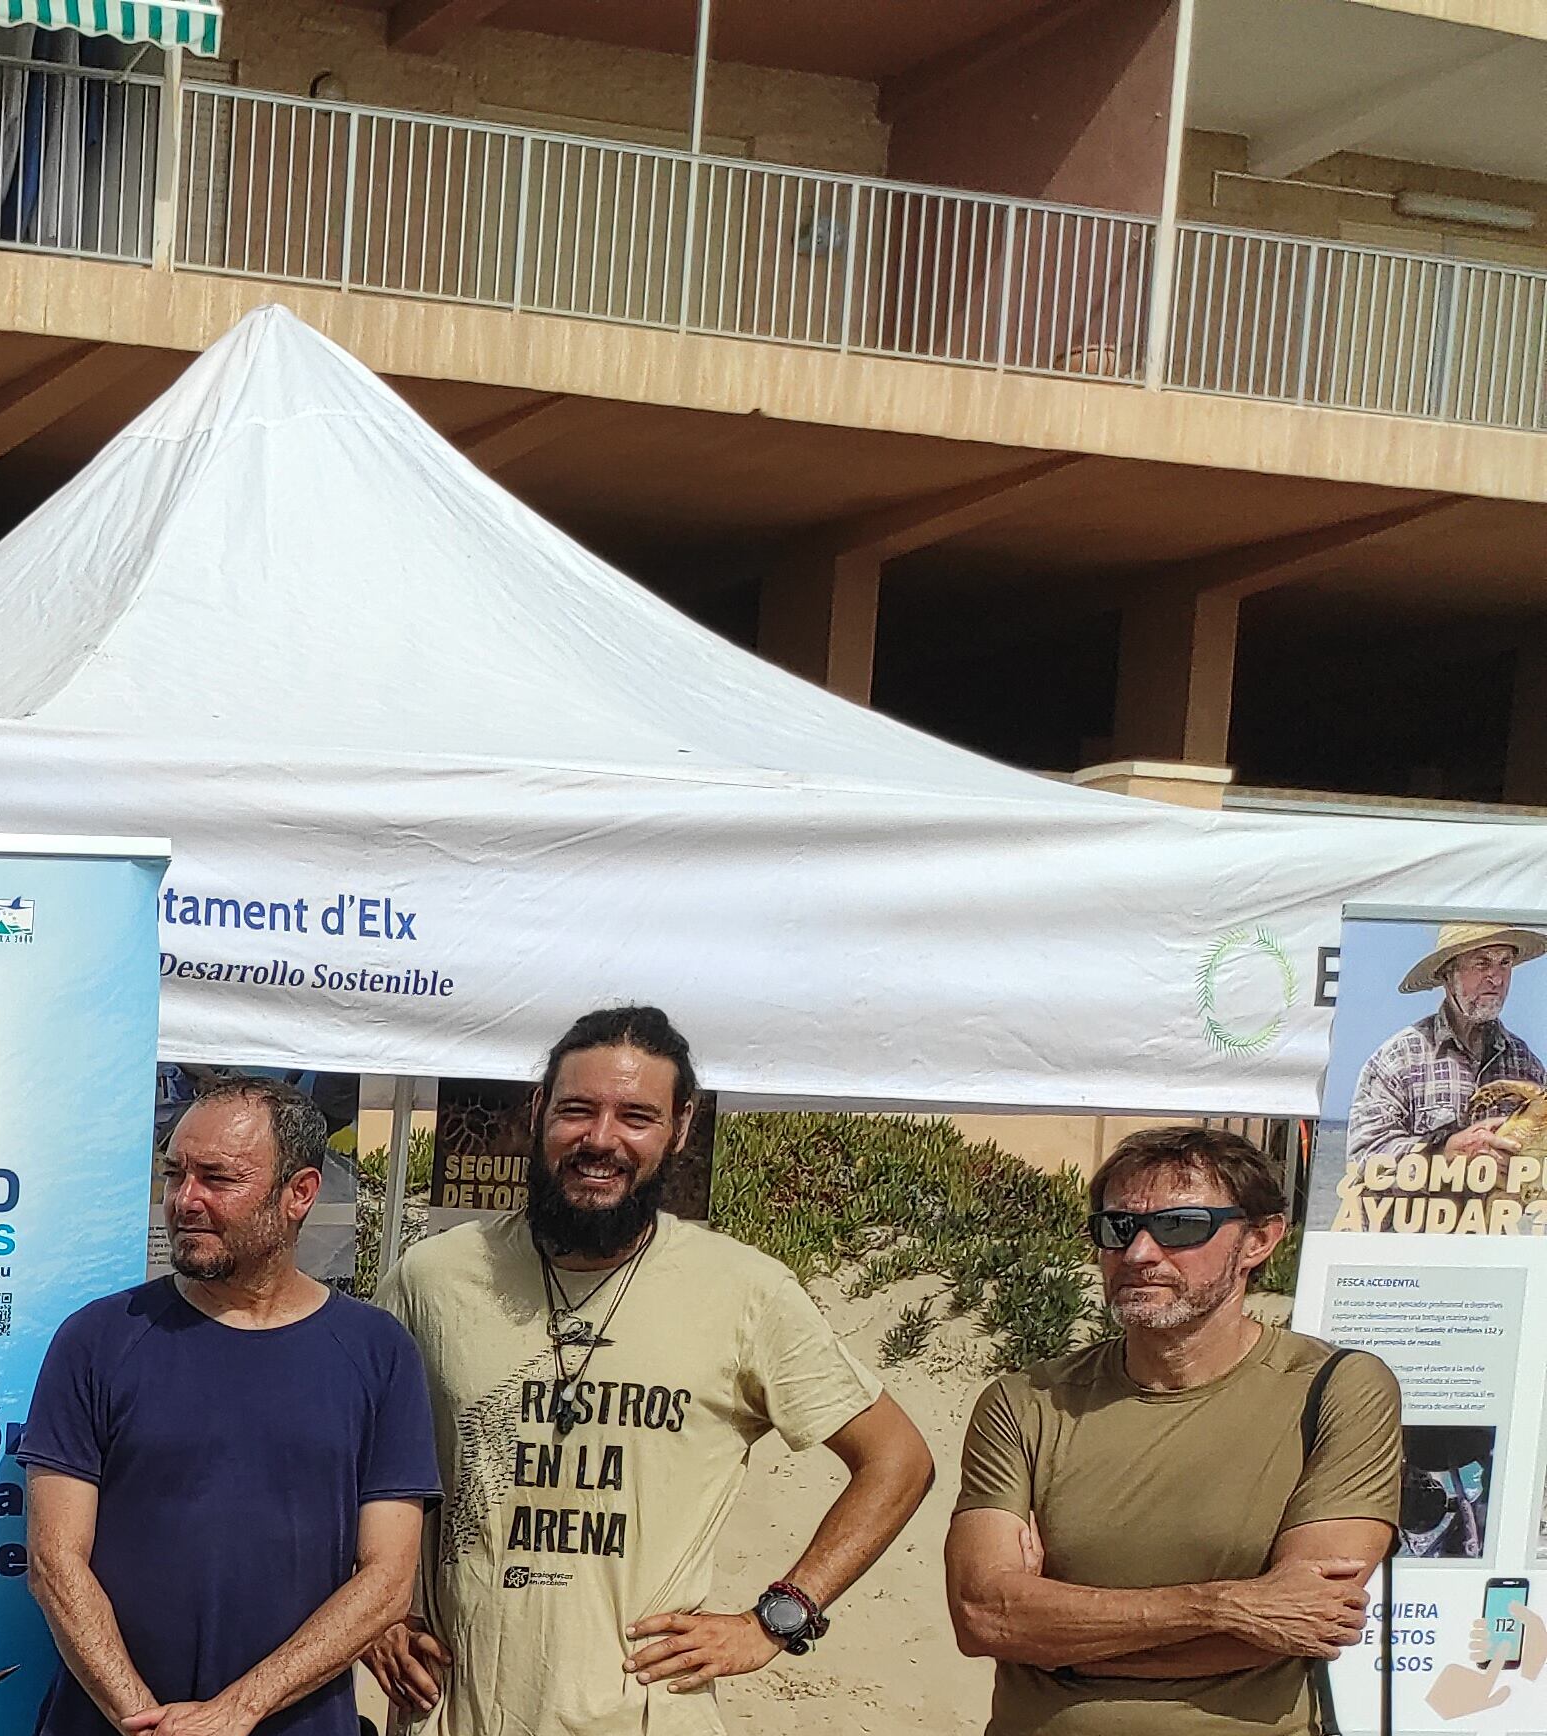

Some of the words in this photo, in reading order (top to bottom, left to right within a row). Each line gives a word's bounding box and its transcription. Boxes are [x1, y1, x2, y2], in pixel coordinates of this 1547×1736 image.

[157, 887, 308, 934] tament
[321, 894, 418, 941] d'Elx
[159, 951, 305, 988] Desarrollo
[311, 963, 455, 997] Sostenible
[443, 1184, 475, 1208] DE
[1337, 1143, 1499, 1198] ¿CÓMO
[1336, 1277, 1365, 1287] PESCA
[520, 1380, 691, 1433] RASTROS
[513, 1441, 563, 1489] EN
[575, 1445, 623, 1491] LA
[507, 1505, 627, 1558] ARENA
